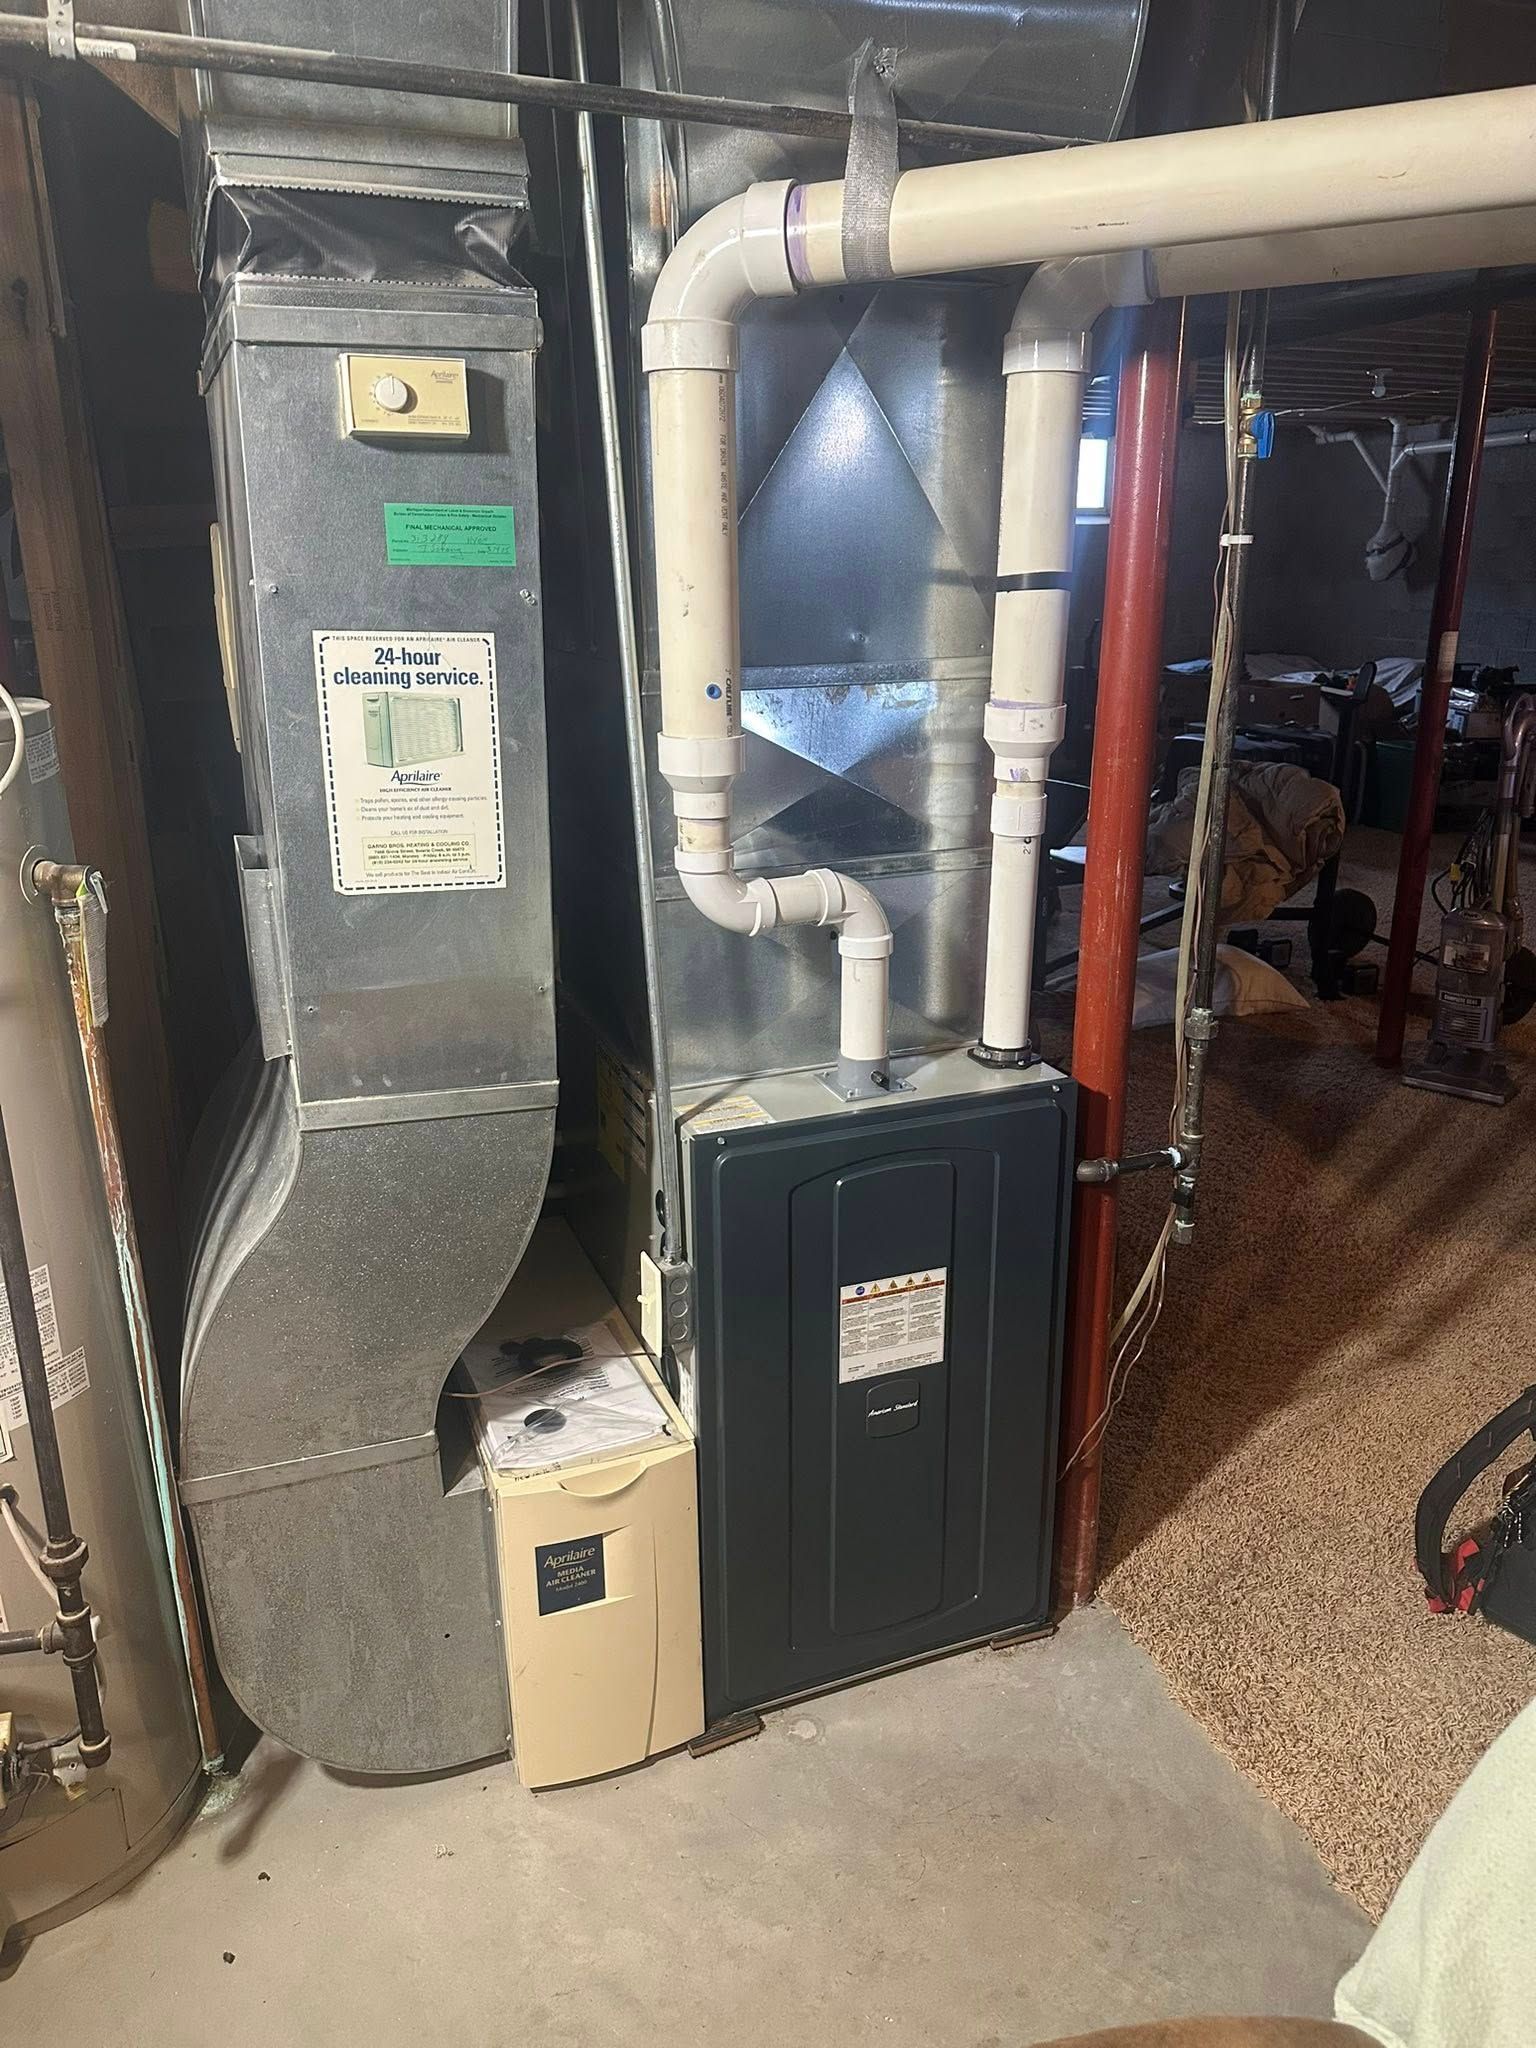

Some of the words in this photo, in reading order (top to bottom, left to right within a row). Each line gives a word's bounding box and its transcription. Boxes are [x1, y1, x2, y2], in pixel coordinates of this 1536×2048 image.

[375, 647, 441, 665] 24-hour
[334, 667, 411, 689] cleaning
[416, 667, 483, 685] service.
[391, 770, 440, 785] Aprilaire
[544, 1547, 595, 1569] Aprilaire
[546, 1579, 560, 1588] AIR
[561, 1569, 596, 1583] CLEANER
[557, 1566, 584, 1577] MEDIA
